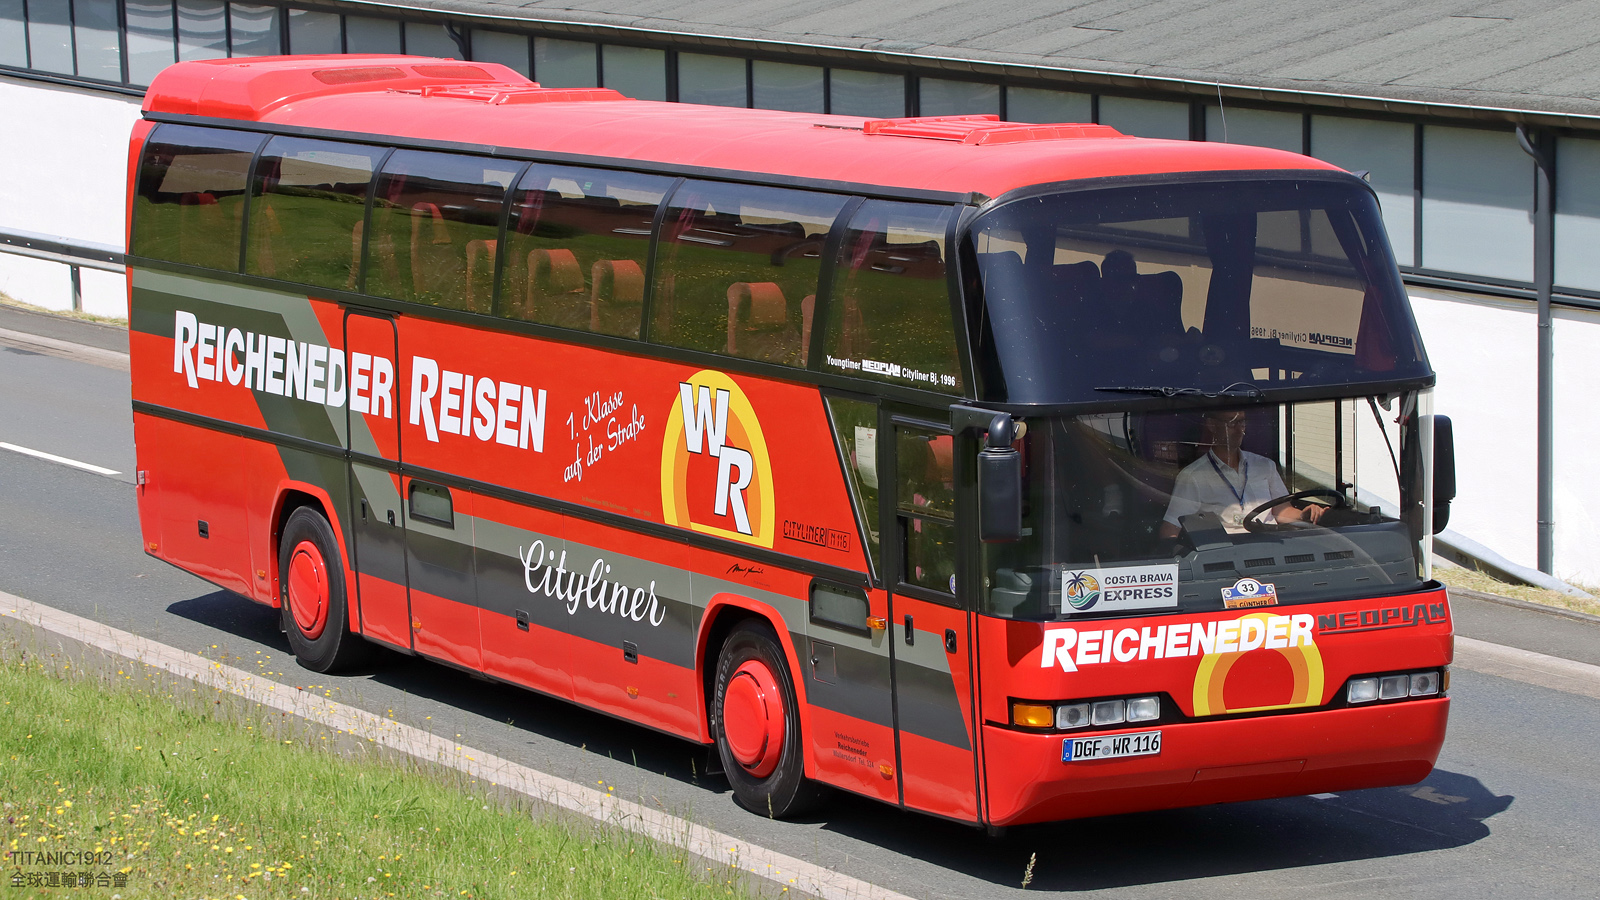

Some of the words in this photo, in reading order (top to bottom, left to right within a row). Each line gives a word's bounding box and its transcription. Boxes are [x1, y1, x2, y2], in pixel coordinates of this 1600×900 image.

[173, 309, 394, 419] REICHENEDER
[409, 355, 547, 453] REISEN
[826, 354, 861, 370] Youngtimer
[862, 359, 901, 378] NEOPLAN
[902, 367, 930, 382] Cityliner
[930, 372, 940, 385] Bj.
[940, 374, 956, 387] 1996
[566, 411, 579, 440] 1.
[582, 390, 624, 431] Klasse
[564, 442, 583, 483] auf
[586, 434, 604, 467] der
[606, 403, 646, 452] Straße
[783, 520, 826, 546] CITYLINER
[519, 539, 666, 627] Cityliner
[1104, 575, 1138, 585] COSTA
[1140, 572, 1173, 583] BRAVA
[1104, 587, 1173, 602] EXPRESS
[1242, 583, 1255, 592] 33
[1318, 602, 1446, 634] NEOPLAN
[1040, 613, 1315, 672] REICHENEDER
[838, 741, 868, 756] Reicheneder
[1074, 740, 1102, 758] DGF
[1112, 737, 1130, 754] WR
[1133, 734, 1160, 753] 116
